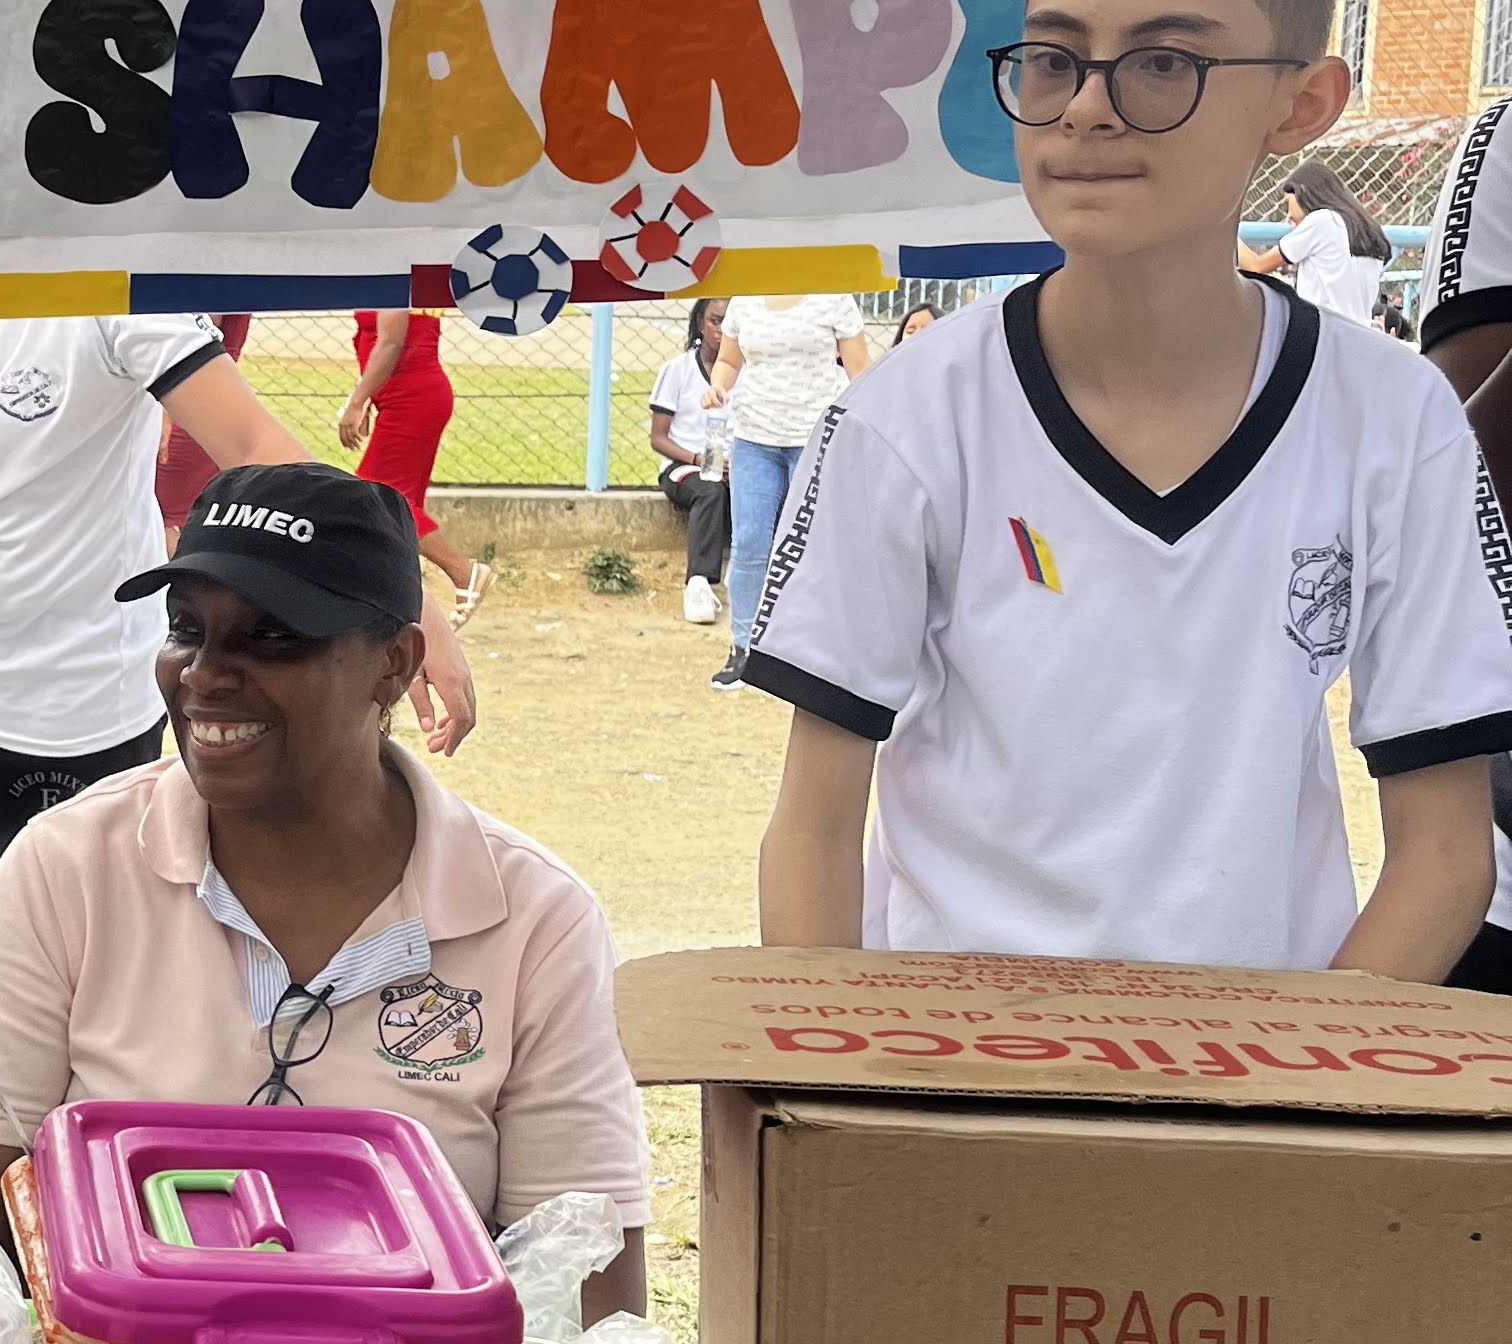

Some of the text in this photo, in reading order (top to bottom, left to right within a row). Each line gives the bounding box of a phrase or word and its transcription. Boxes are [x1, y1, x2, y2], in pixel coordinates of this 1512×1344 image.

[202, 502, 314, 544] LIMEC
[9, 771, 88, 798] LICEO MIXT
[711, 975, 836, 987] YUMBO
[841, 977, 976, 991] PLANTA
[1057, 985, 1248, 1002] COLOMBIA
[751, 1003, 910, 1020] todos
[926, 1009, 994, 1024] de
[1013, 1010, 1234, 1031] alcance
[1248, 1017, 1299, 1035] al
[434, 1072, 461, 1082] CALI
